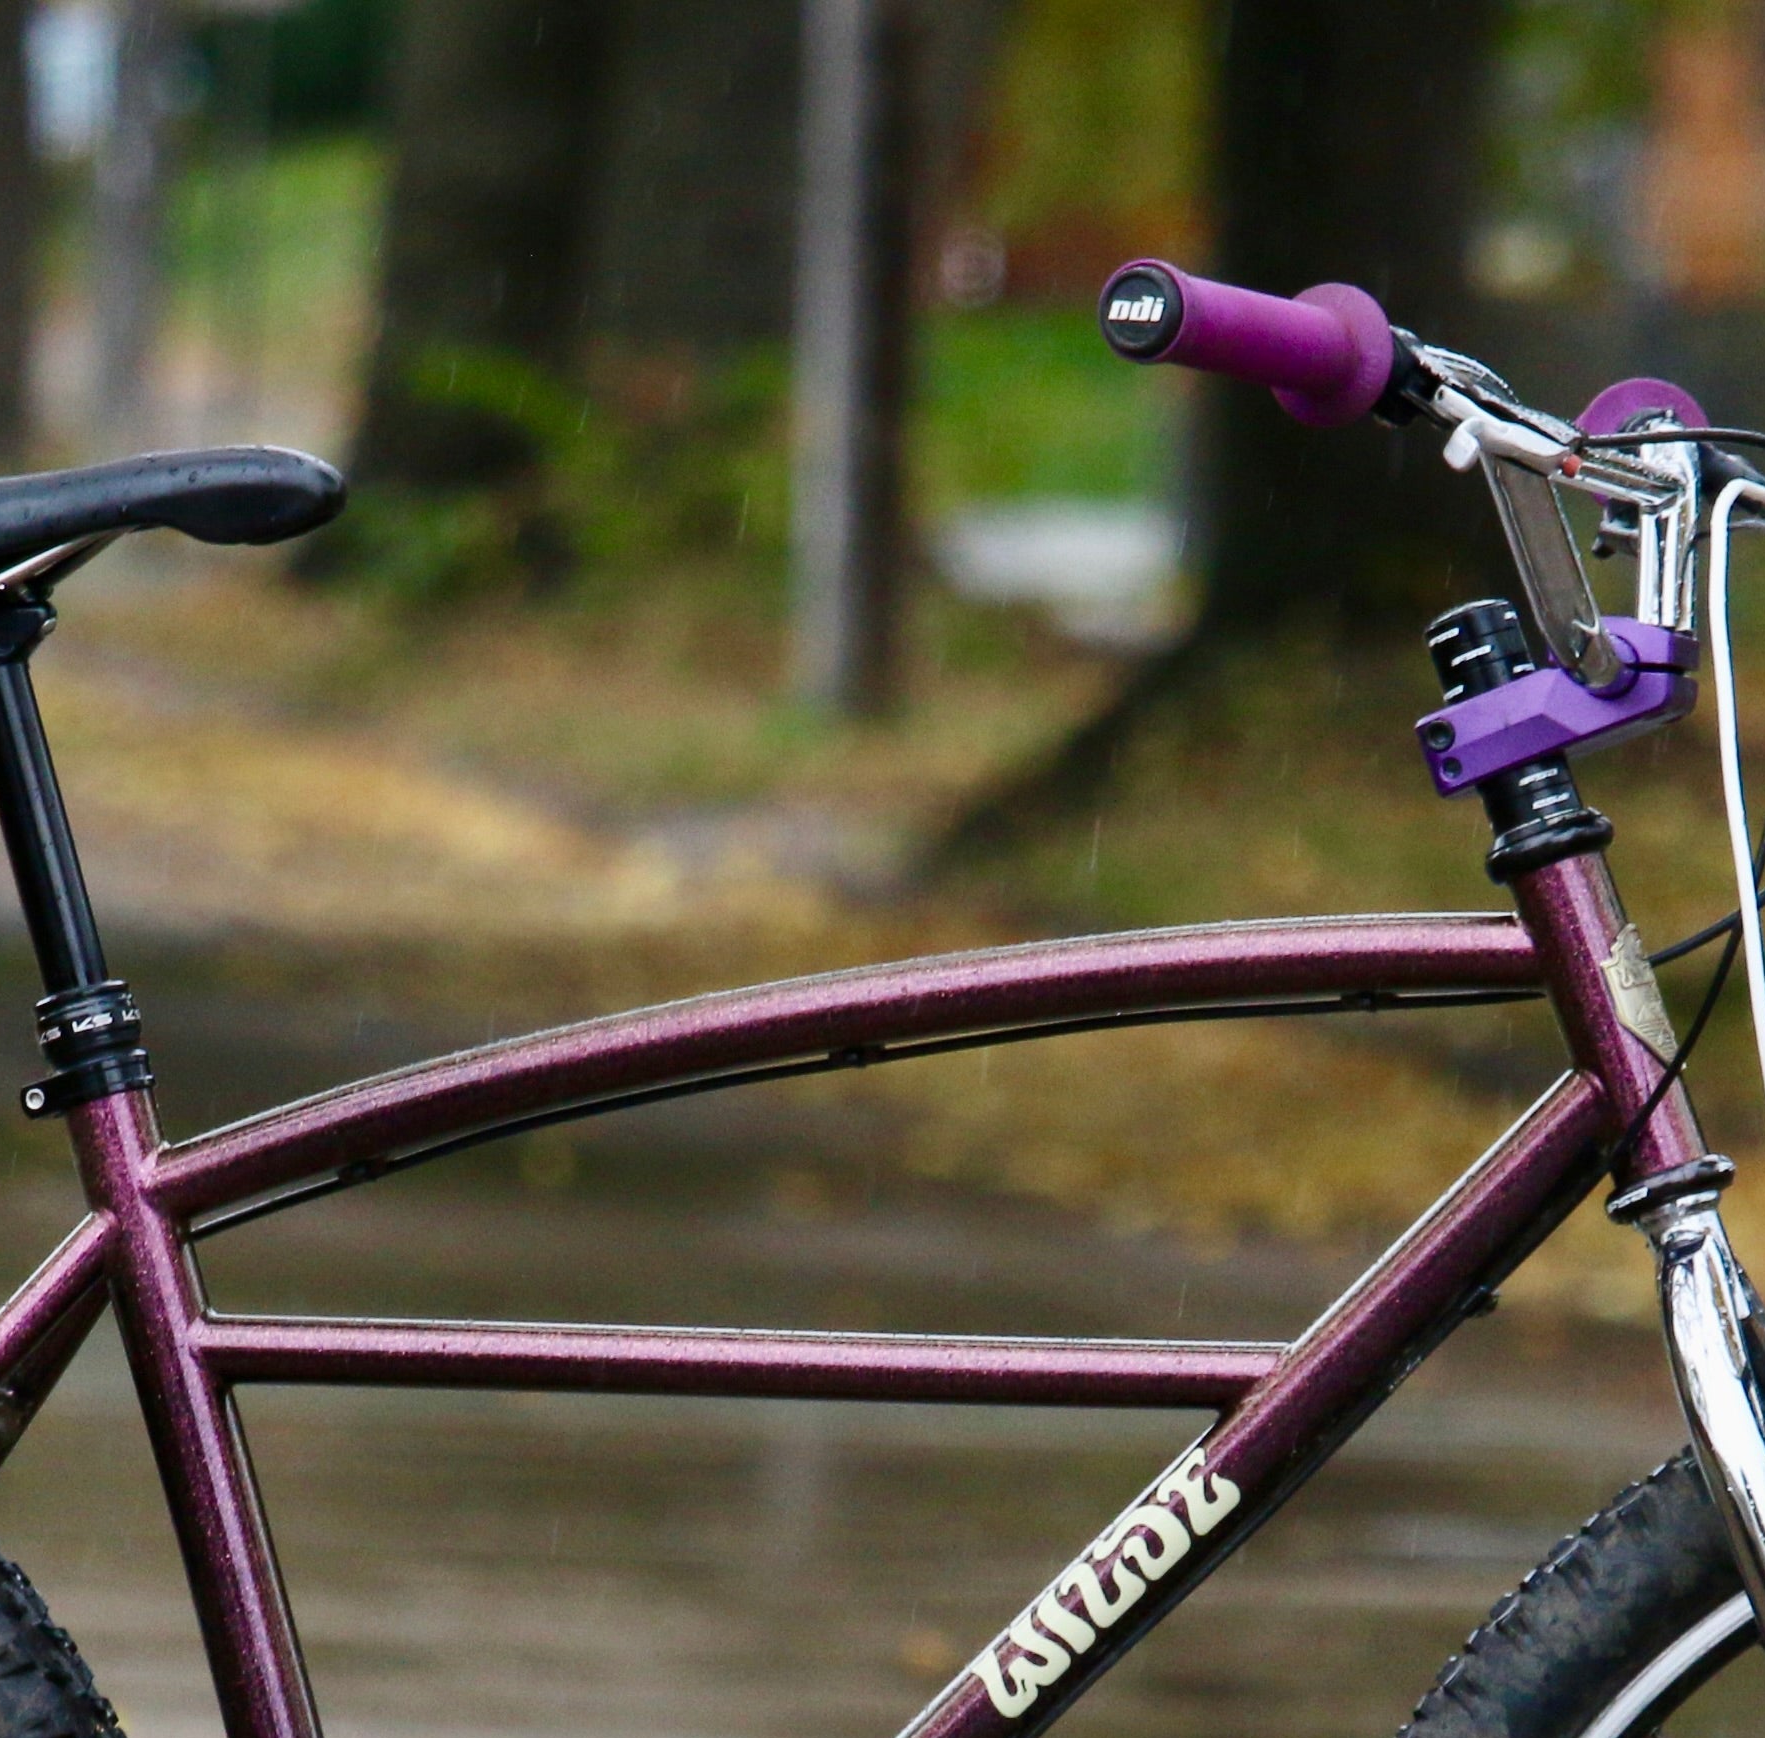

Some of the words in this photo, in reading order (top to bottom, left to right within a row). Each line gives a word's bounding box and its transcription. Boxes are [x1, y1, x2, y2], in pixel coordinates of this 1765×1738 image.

[1107, 295, 1166, 323] odi
[71, 1012, 113, 1033] KS
[971, 1447, 1241, 1719] WILDE
